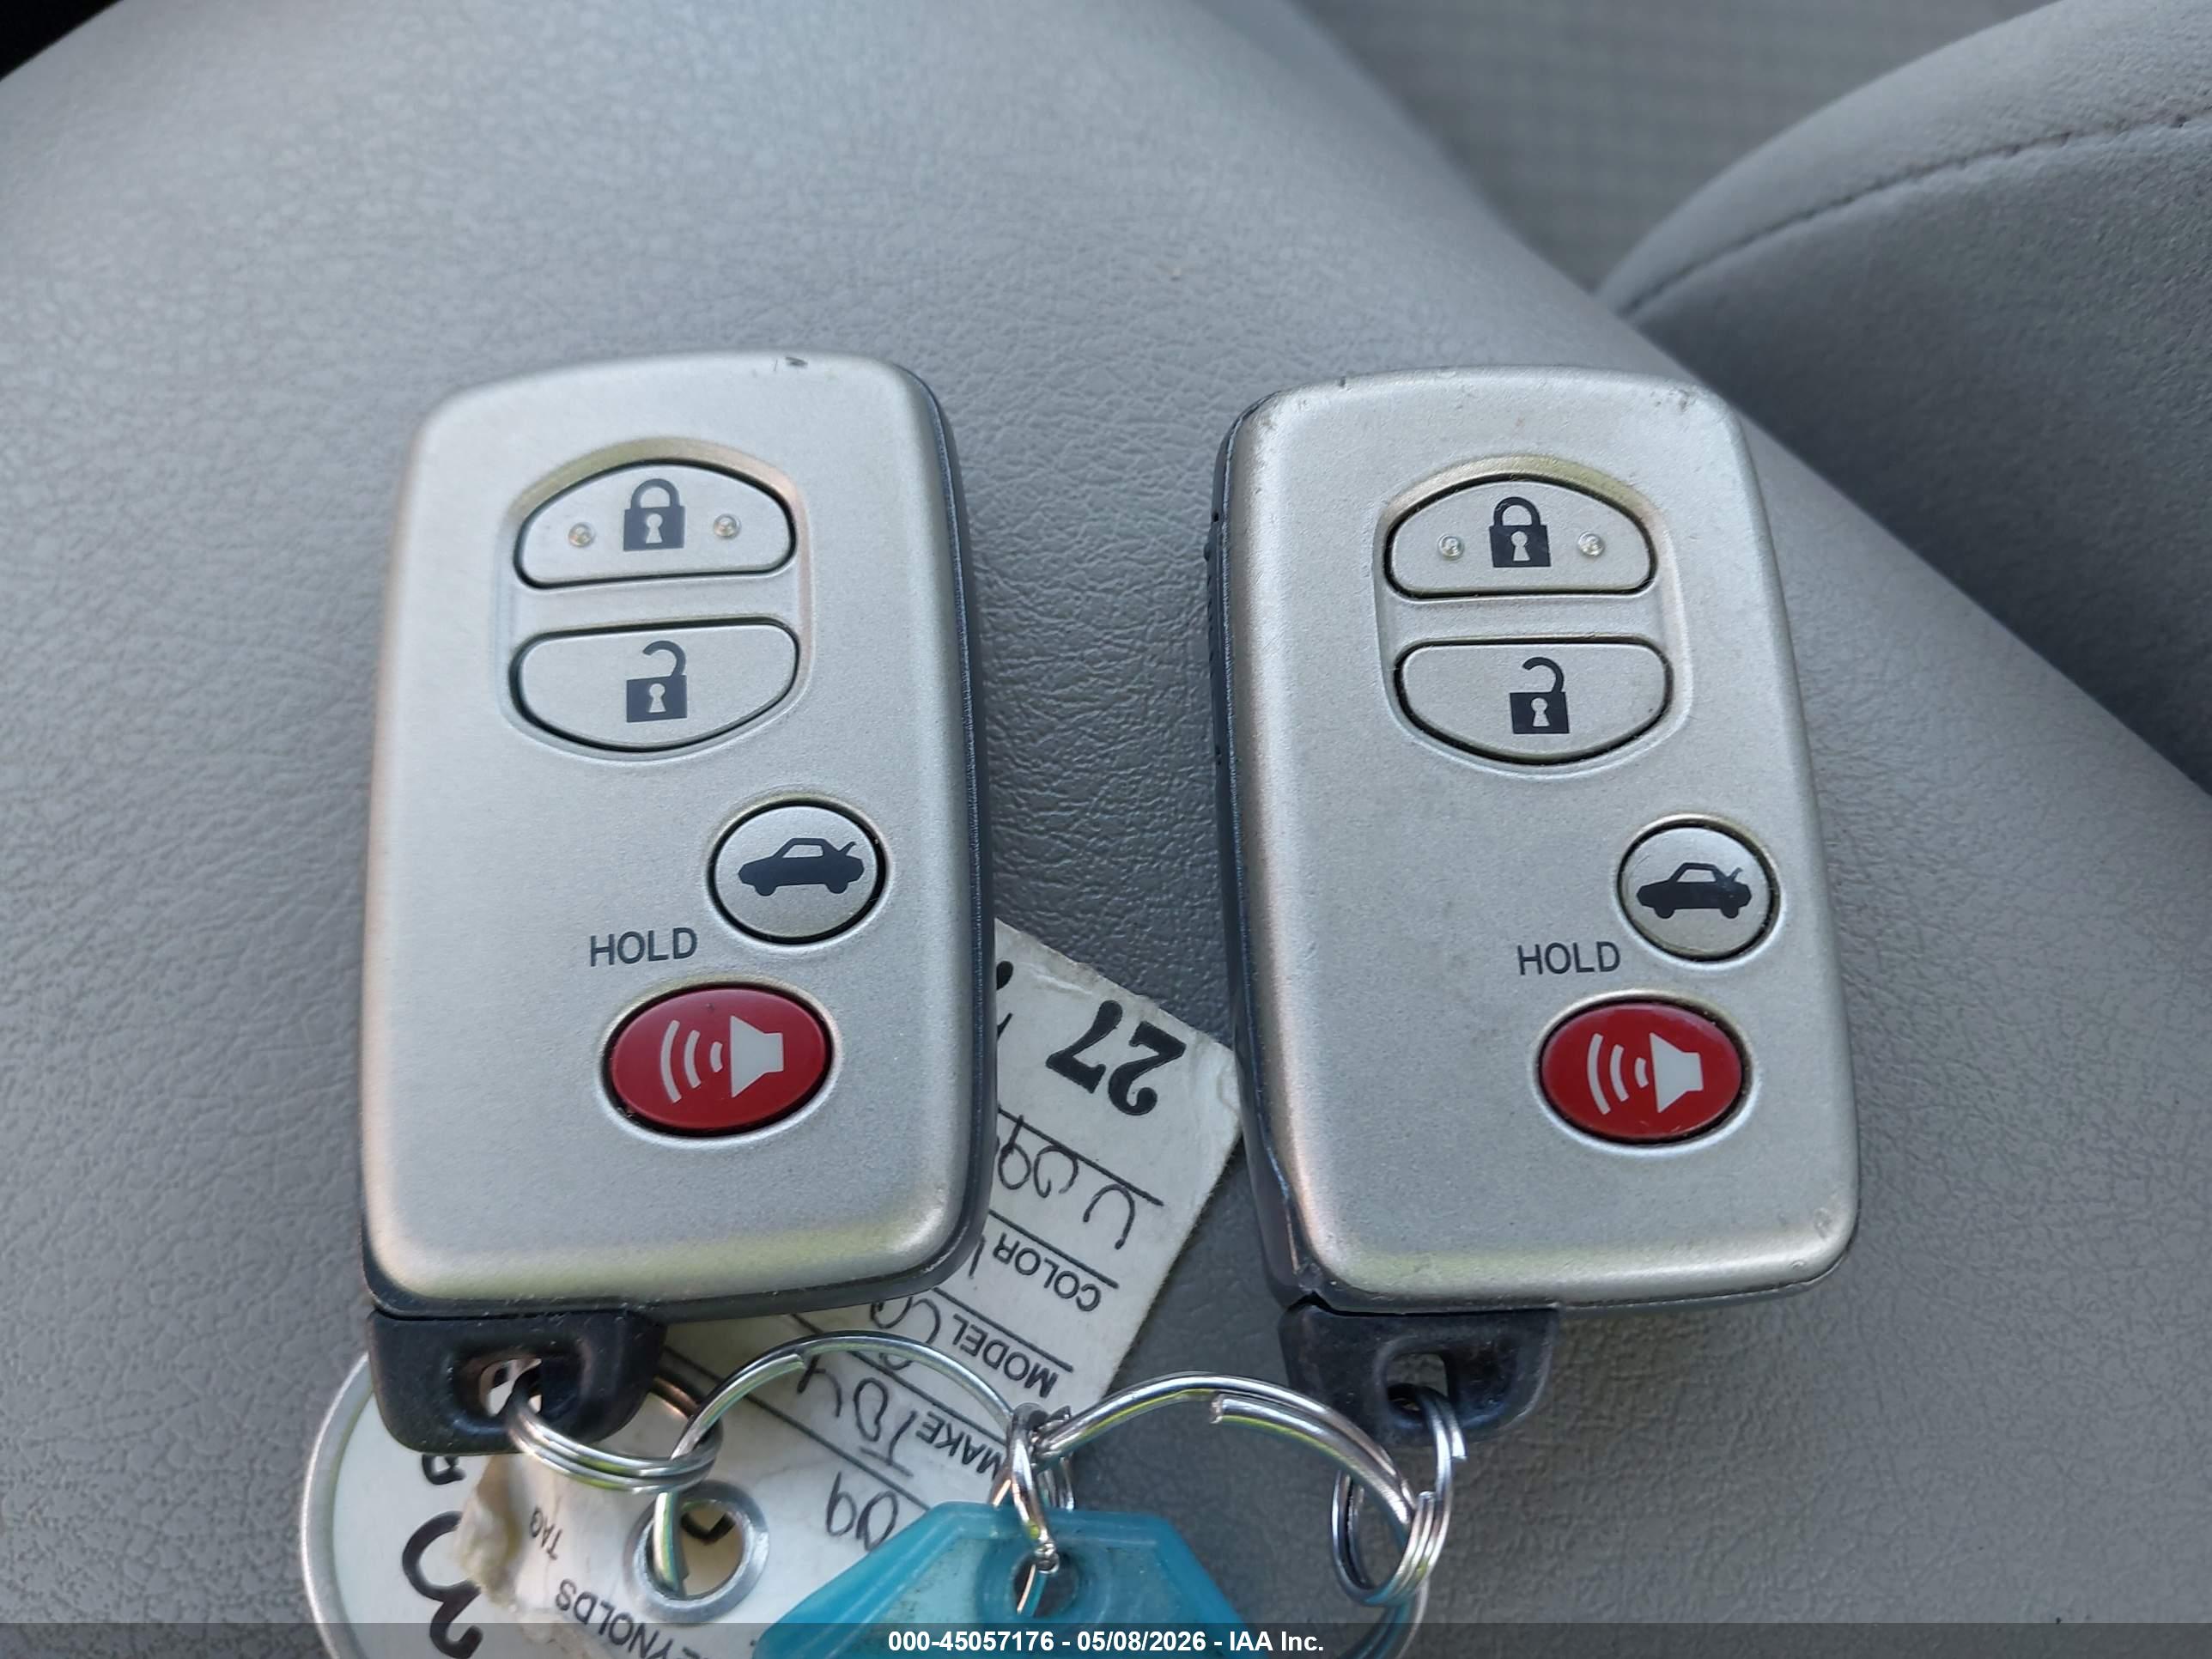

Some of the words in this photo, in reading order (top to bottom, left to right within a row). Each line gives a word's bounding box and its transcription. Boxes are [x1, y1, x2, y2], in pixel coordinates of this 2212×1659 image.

[590, 927, 698, 967] HOLD
[1517, 941, 1621, 976] HOLD
[1045, 1000, 1187, 1116] 27
[992, 1232, 1102, 1312] COLOR
[951, 1313, 1059, 1399] MODEL
[915, 1411, 1005, 1480] MAKE
